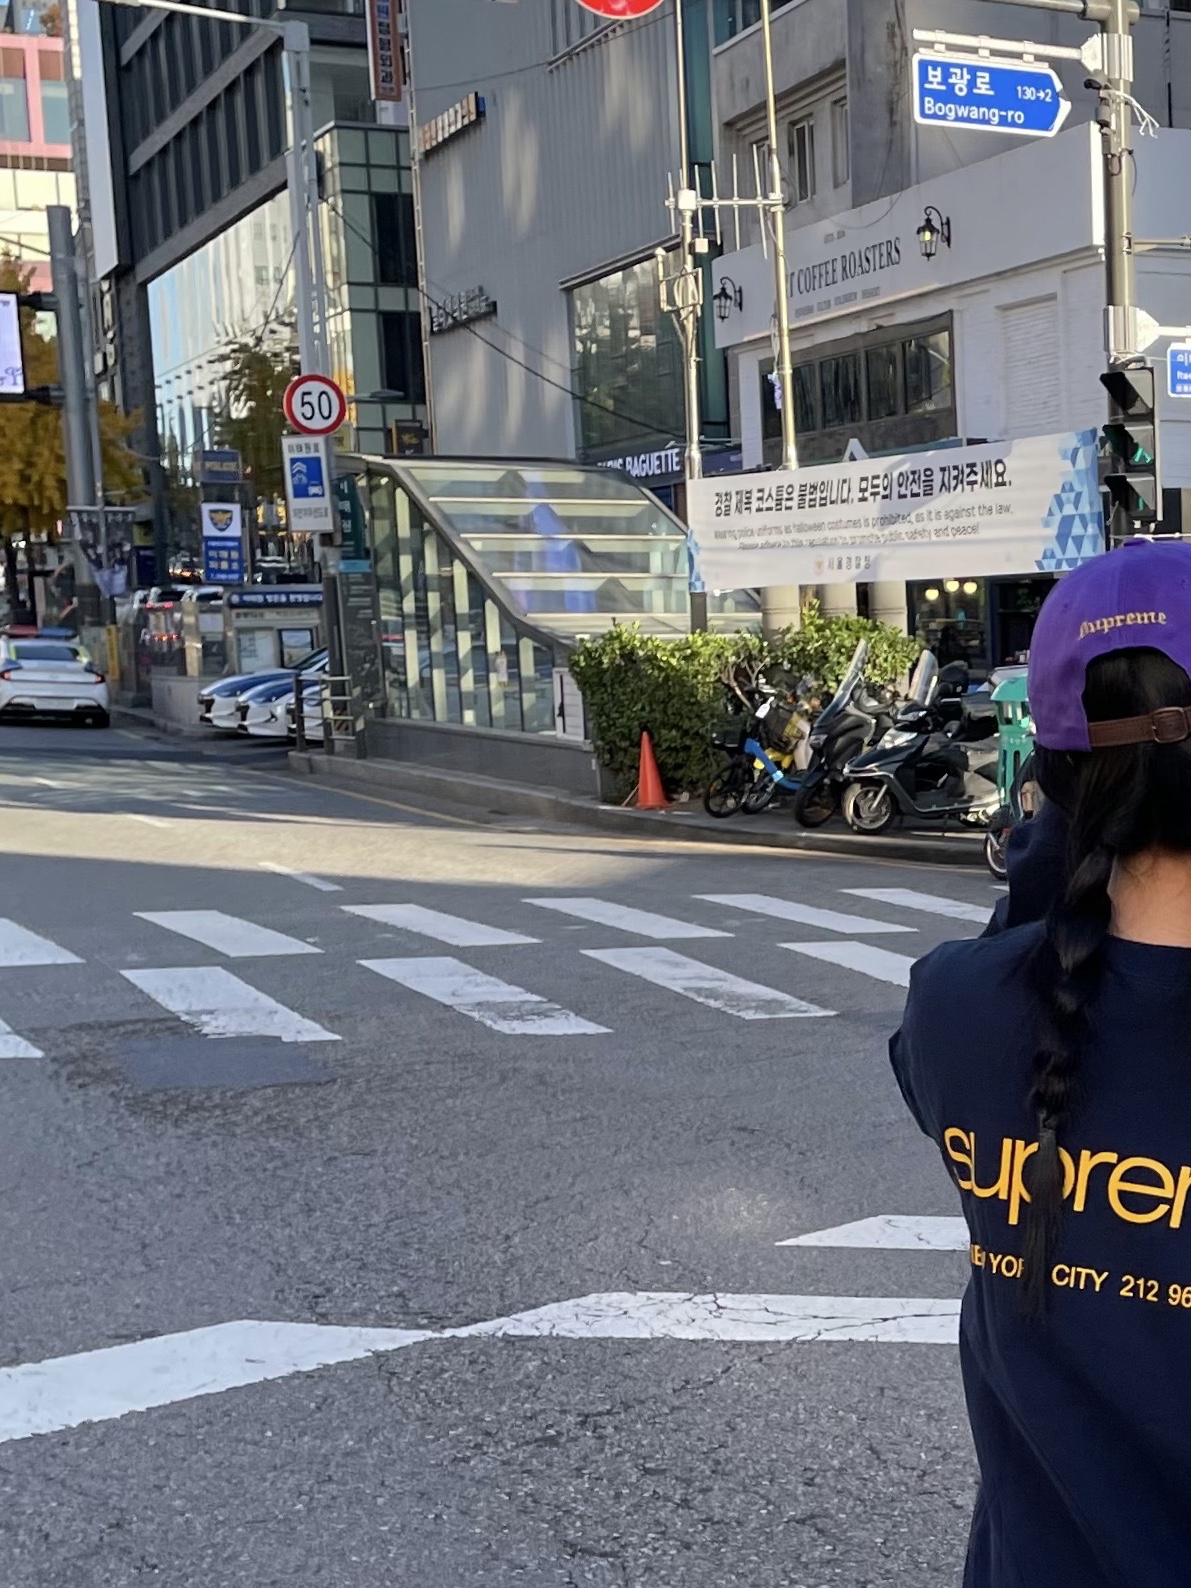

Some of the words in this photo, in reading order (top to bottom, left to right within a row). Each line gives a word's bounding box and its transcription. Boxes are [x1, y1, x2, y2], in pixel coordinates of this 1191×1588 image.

[923, 65, 995, 97] 보광로
[923, 97, 1025, 124] Bogwang-ro
[797, 257, 838, 295] COFFEE
[841, 236, 901, 282] ROASTERS
[301, 391, 332, 420] 50
[626, 448, 680, 477] BAGUETTE
[714, 491, 732, 517] 경찰
[734, 489, 753, 514] 제복
[797, 478, 854, 510] 불법입니다.
[858, 472, 893, 502] 모두의
[897, 467, 934, 499] 안전을
[938, 458, 1012, 494] 지켜주세요.
[872, 511, 914, 529] prohibited,
[915, 512, 925, 522] as
[935, 509, 942, 519] is
[944, 506, 976, 521] against
[978, 503, 993, 517] the
[1077, 609, 1167, 640] Supreme
[1051, 1264, 1109, 1292] CITY
[1120, 1275, 1159, 1302] 212
